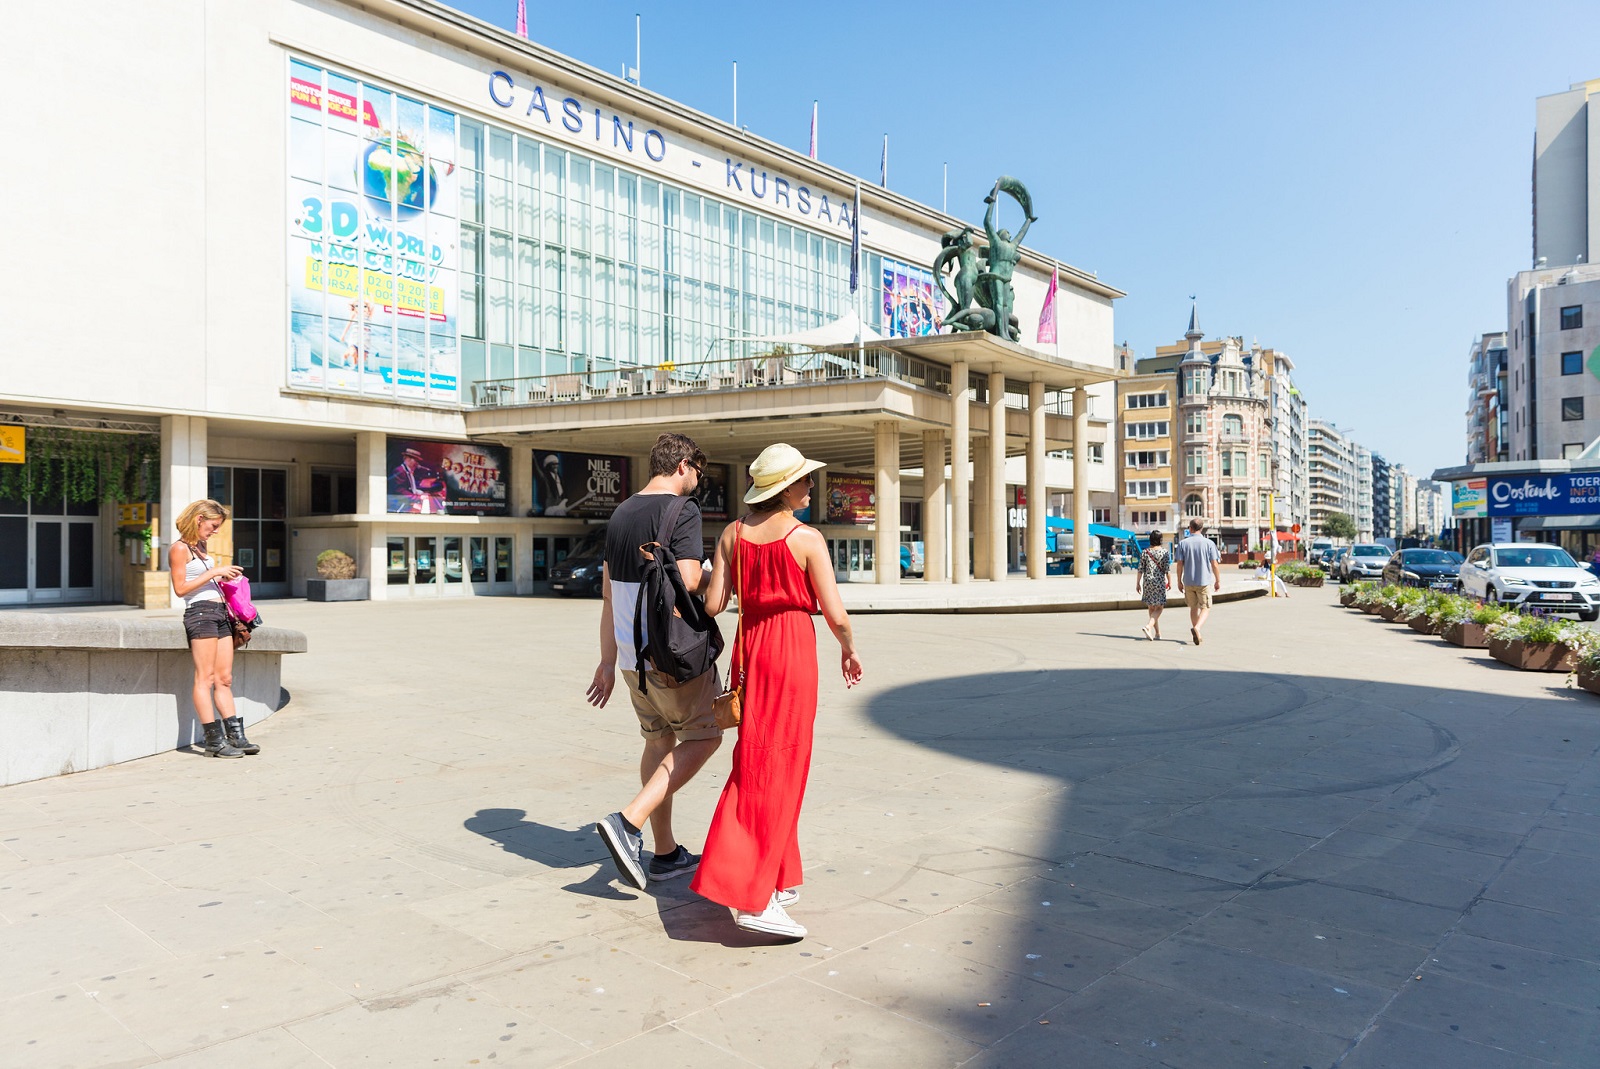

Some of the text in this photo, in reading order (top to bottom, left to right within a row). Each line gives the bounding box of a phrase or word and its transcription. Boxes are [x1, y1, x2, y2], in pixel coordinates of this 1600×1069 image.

[291, 89, 310, 103] FUN
[488, 70, 666, 162] CASINO
[726, 158, 868, 236] KURSAA
[302, 197, 442, 261] 3D WORLD
[311, 240, 377, 267] MAGIC
[406, 259, 436, 279] FUN
[311, 274, 439, 311] KURSAAL OOSTENDE
[463, 451, 487, 466] THE
[588, 459, 611, 471] NILE
[441, 456, 500, 481] ROCKET
[592, 470, 620, 479] RODGERS
[459, 477, 489, 494] MAN
[586, 476, 620, 494] CHIC
[1492, 478, 1561, 503] Oostende
[1569, 487, 1596, 496] INFO
